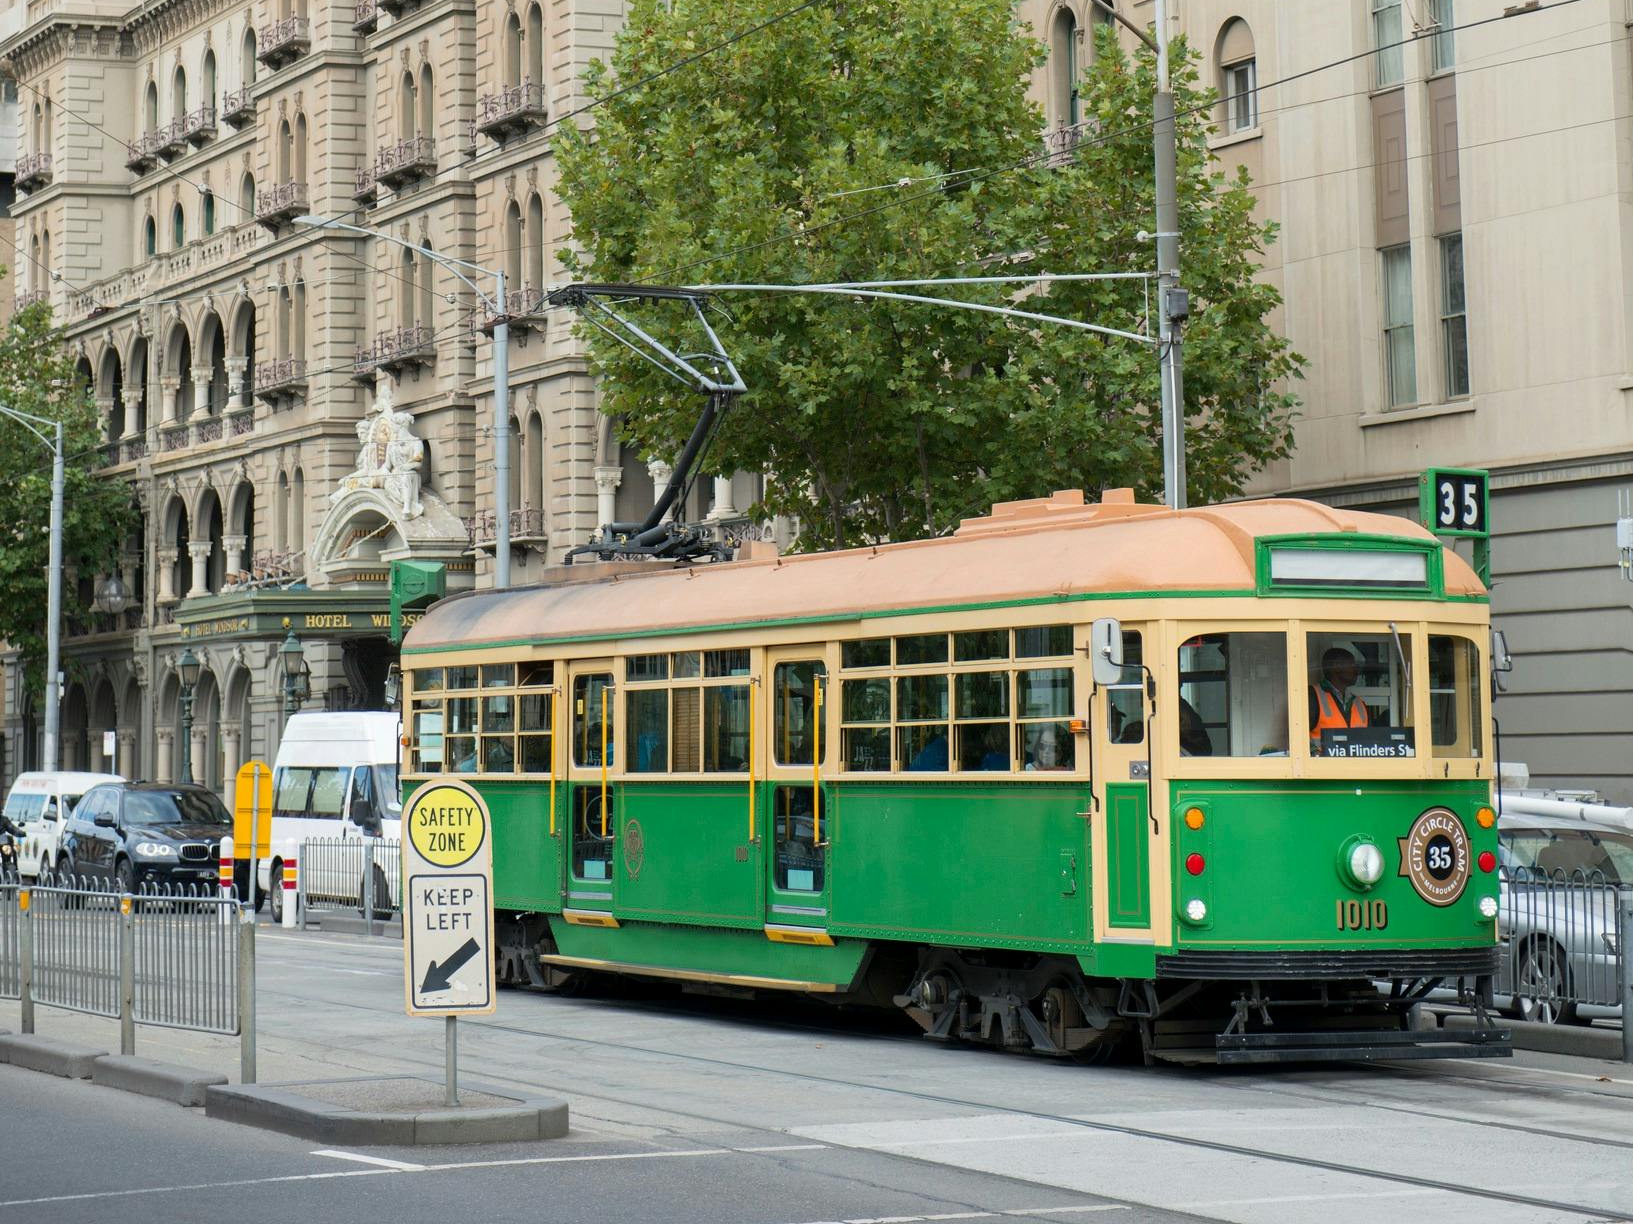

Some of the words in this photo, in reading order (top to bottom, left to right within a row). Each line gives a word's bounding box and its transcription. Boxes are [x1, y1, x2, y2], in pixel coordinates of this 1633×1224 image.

[1440, 481, 1478, 526] 35
[305, 614, 351, 627] HOTEL
[1328, 745, 1346, 757] via
[1349, 744, 1395, 757] Flinders
[420, 807, 473, 827] SAFETY
[428, 832, 466, 852] ZONE
[1413, 837, 1423, 872] CITY
[1420, 817, 1455, 837] CIRCLE
[1453, 828, 1466, 872] TRAM
[1428, 846, 1452, 869] 35
[423, 888, 473, 906] KEEP
[1424, 879, 1457, 895] MELBOURNE
[426, 912, 472, 930] LEFT
[1336, 899, 1389, 931] 1010
